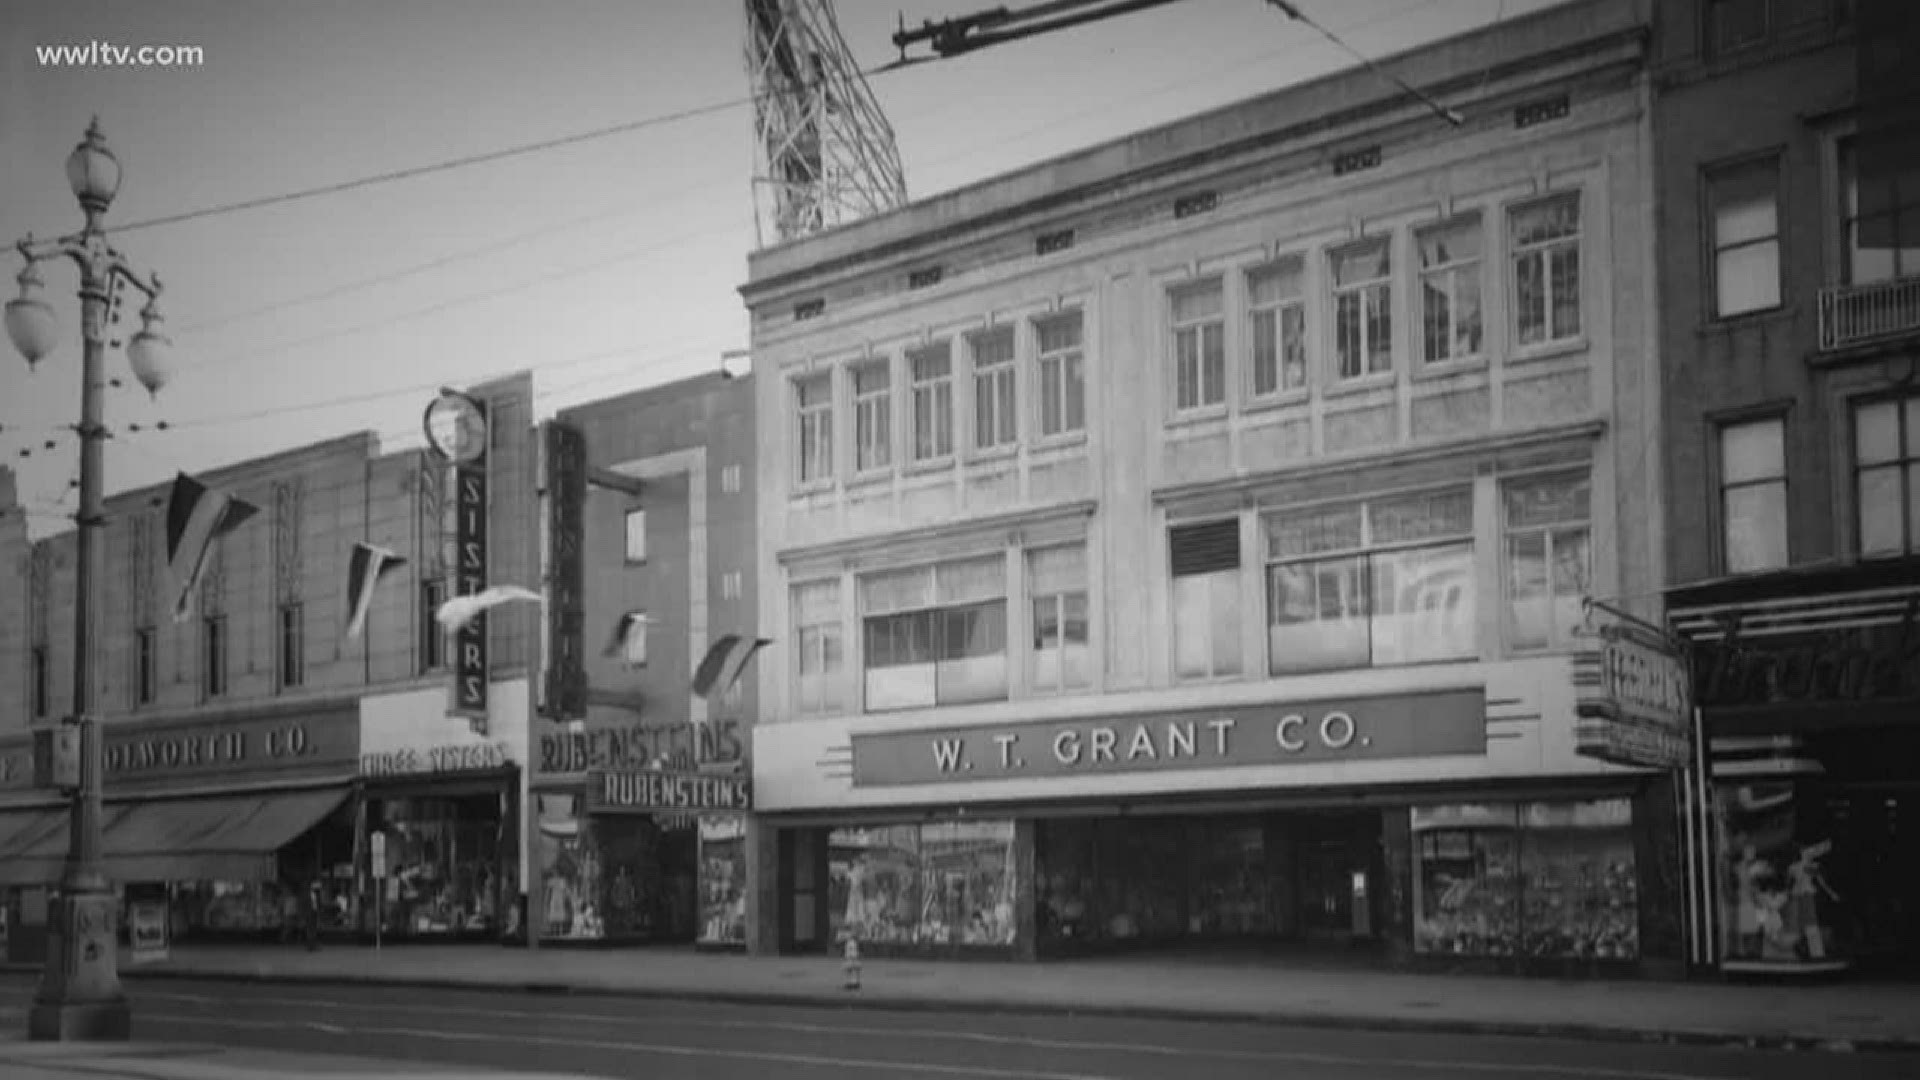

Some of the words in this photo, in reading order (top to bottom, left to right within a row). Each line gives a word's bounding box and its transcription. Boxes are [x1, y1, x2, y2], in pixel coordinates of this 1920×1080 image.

[933, 735, 974, 774] W.
[992, 732, 1025, 769] T.
[1055, 719, 1237, 766] GRANT
[1276, 710, 1372, 752] CO.
